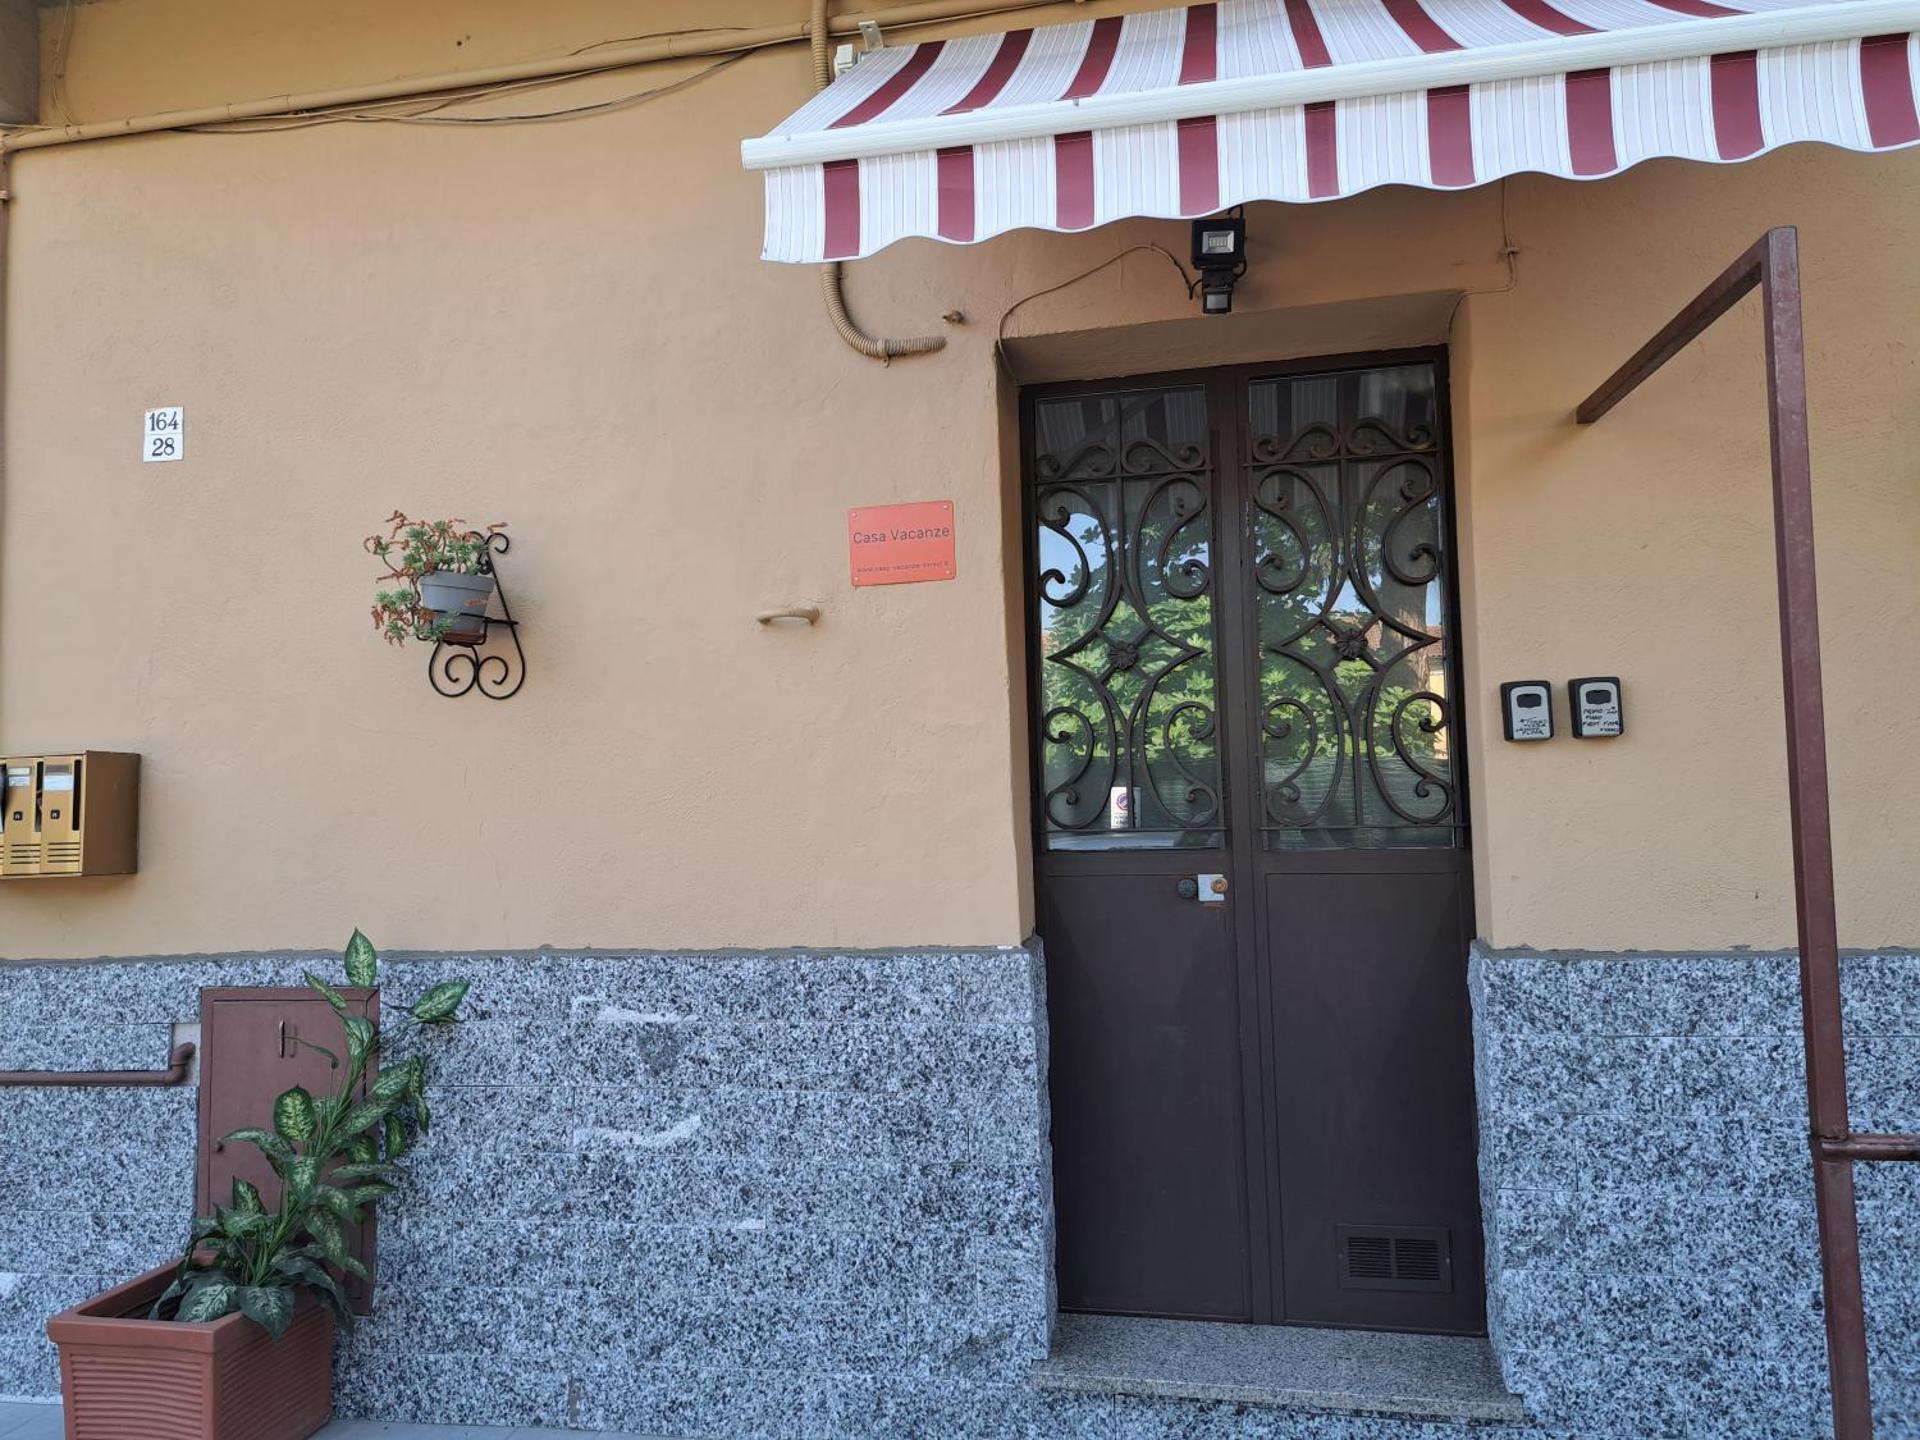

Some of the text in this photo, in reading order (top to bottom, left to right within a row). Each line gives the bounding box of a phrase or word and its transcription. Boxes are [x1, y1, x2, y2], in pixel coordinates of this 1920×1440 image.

[149, 411, 180, 431] 164
[152, 437, 175, 456] 28
[853, 527, 950, 544] Casa Vacanze
